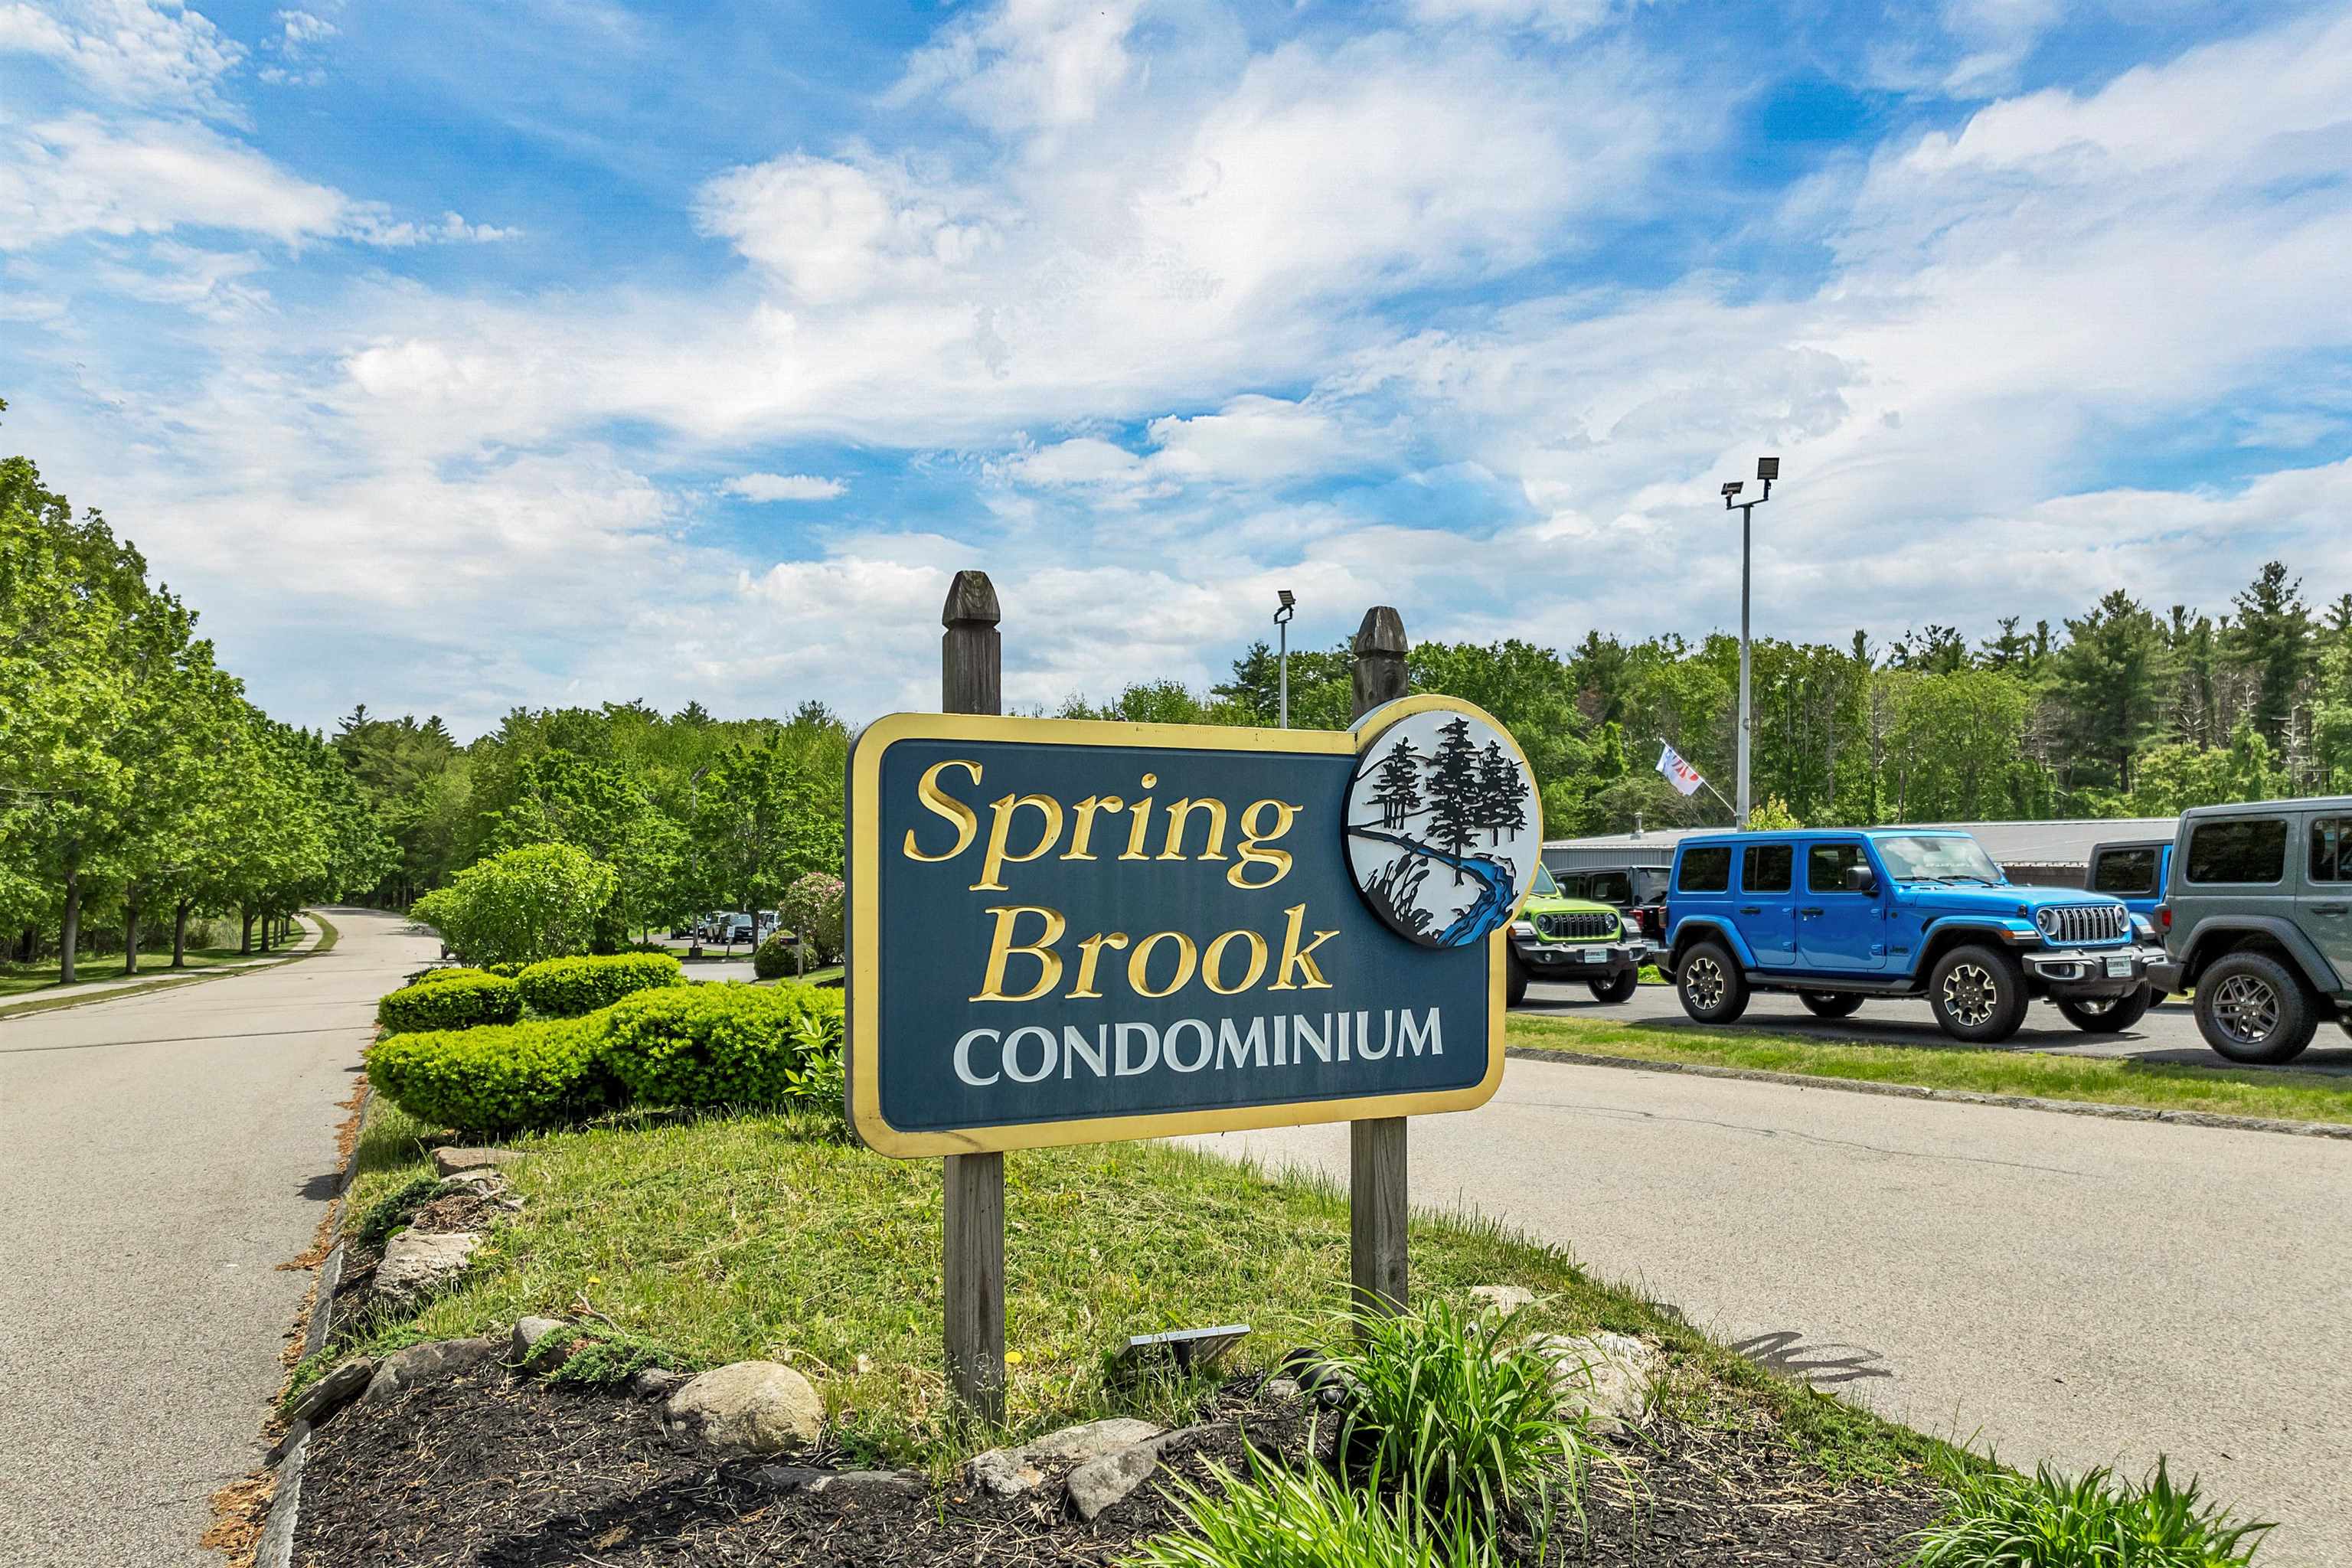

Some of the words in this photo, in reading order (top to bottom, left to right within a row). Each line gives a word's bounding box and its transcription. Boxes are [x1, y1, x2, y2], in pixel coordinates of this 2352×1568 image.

[903, 759, 1304, 891] Spring
[969, 903, 1341, 1002] Brook
[953, 1007, 1443, 1086] CONDOMINIUM
